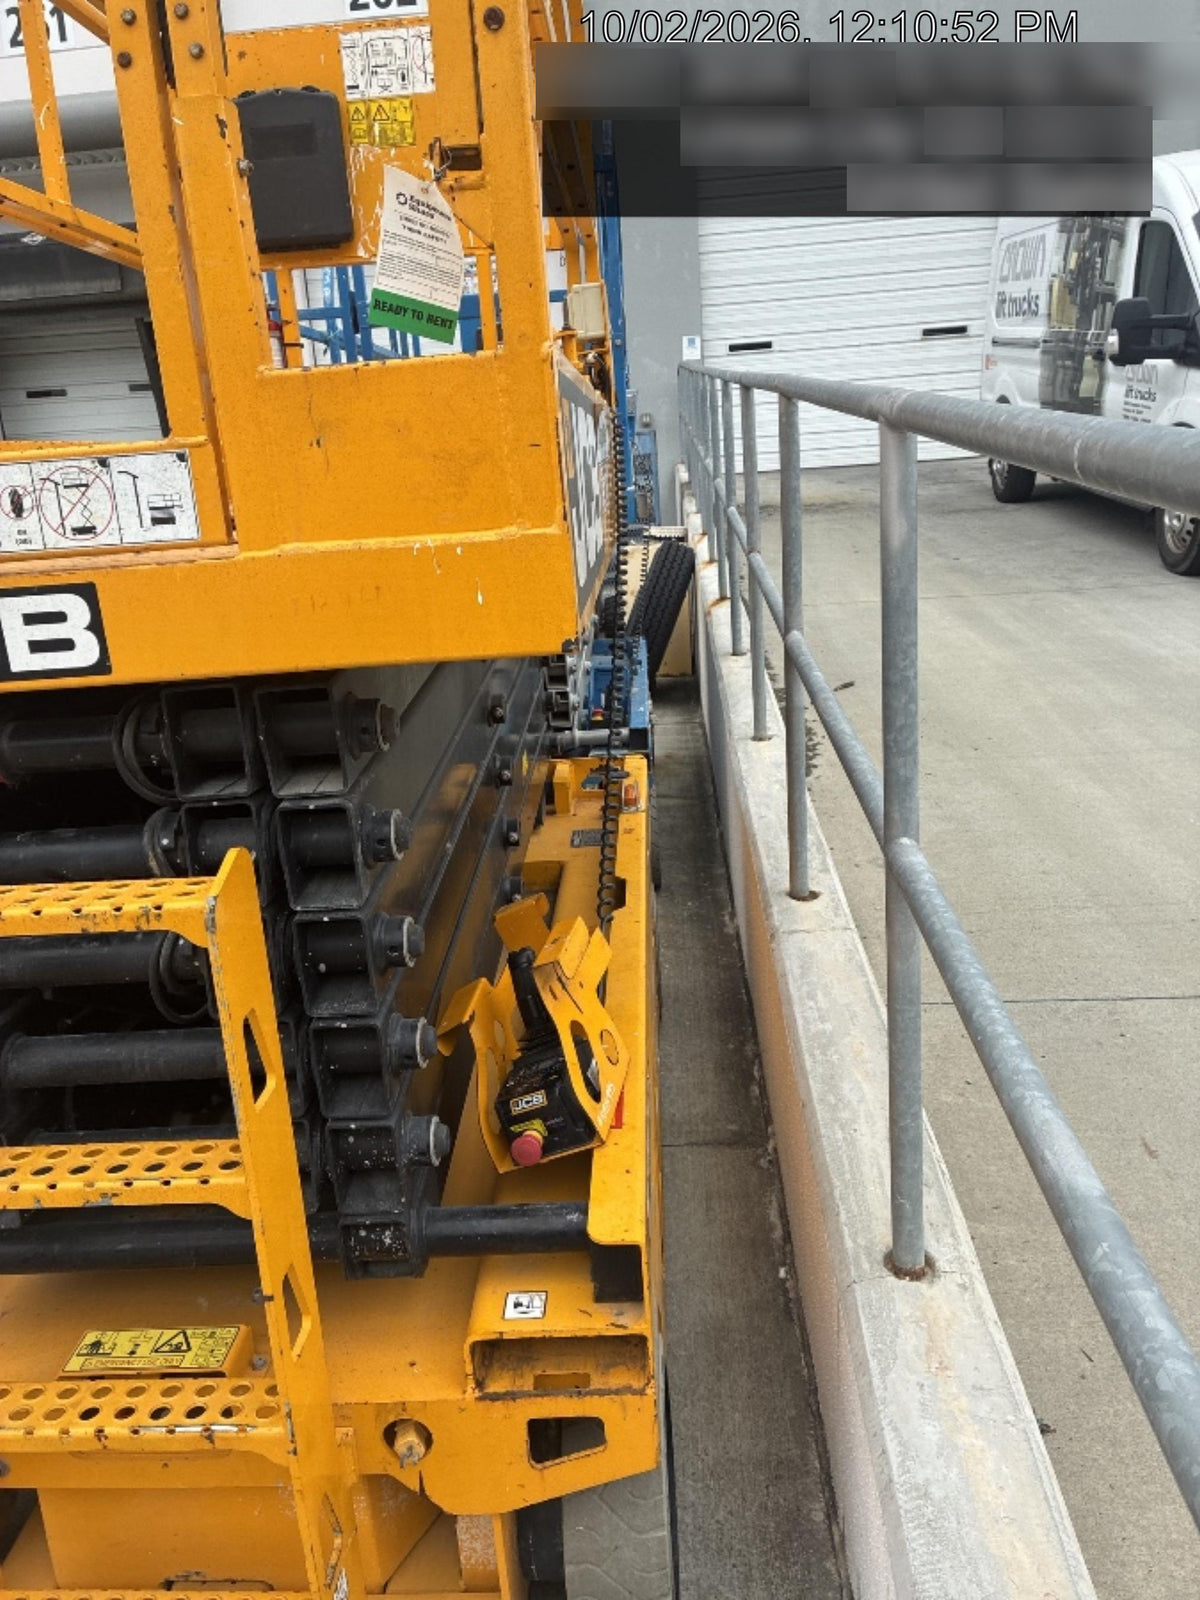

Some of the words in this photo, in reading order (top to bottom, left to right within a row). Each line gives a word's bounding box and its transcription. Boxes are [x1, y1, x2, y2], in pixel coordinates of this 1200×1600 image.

[373, 298, 409, 317] READY
[411, 308, 424, 321] TO
[426, 313, 454, 330] RENT
[1008, 288, 1039, 318] trucks
[514, 1094, 544, 1111] JCB
